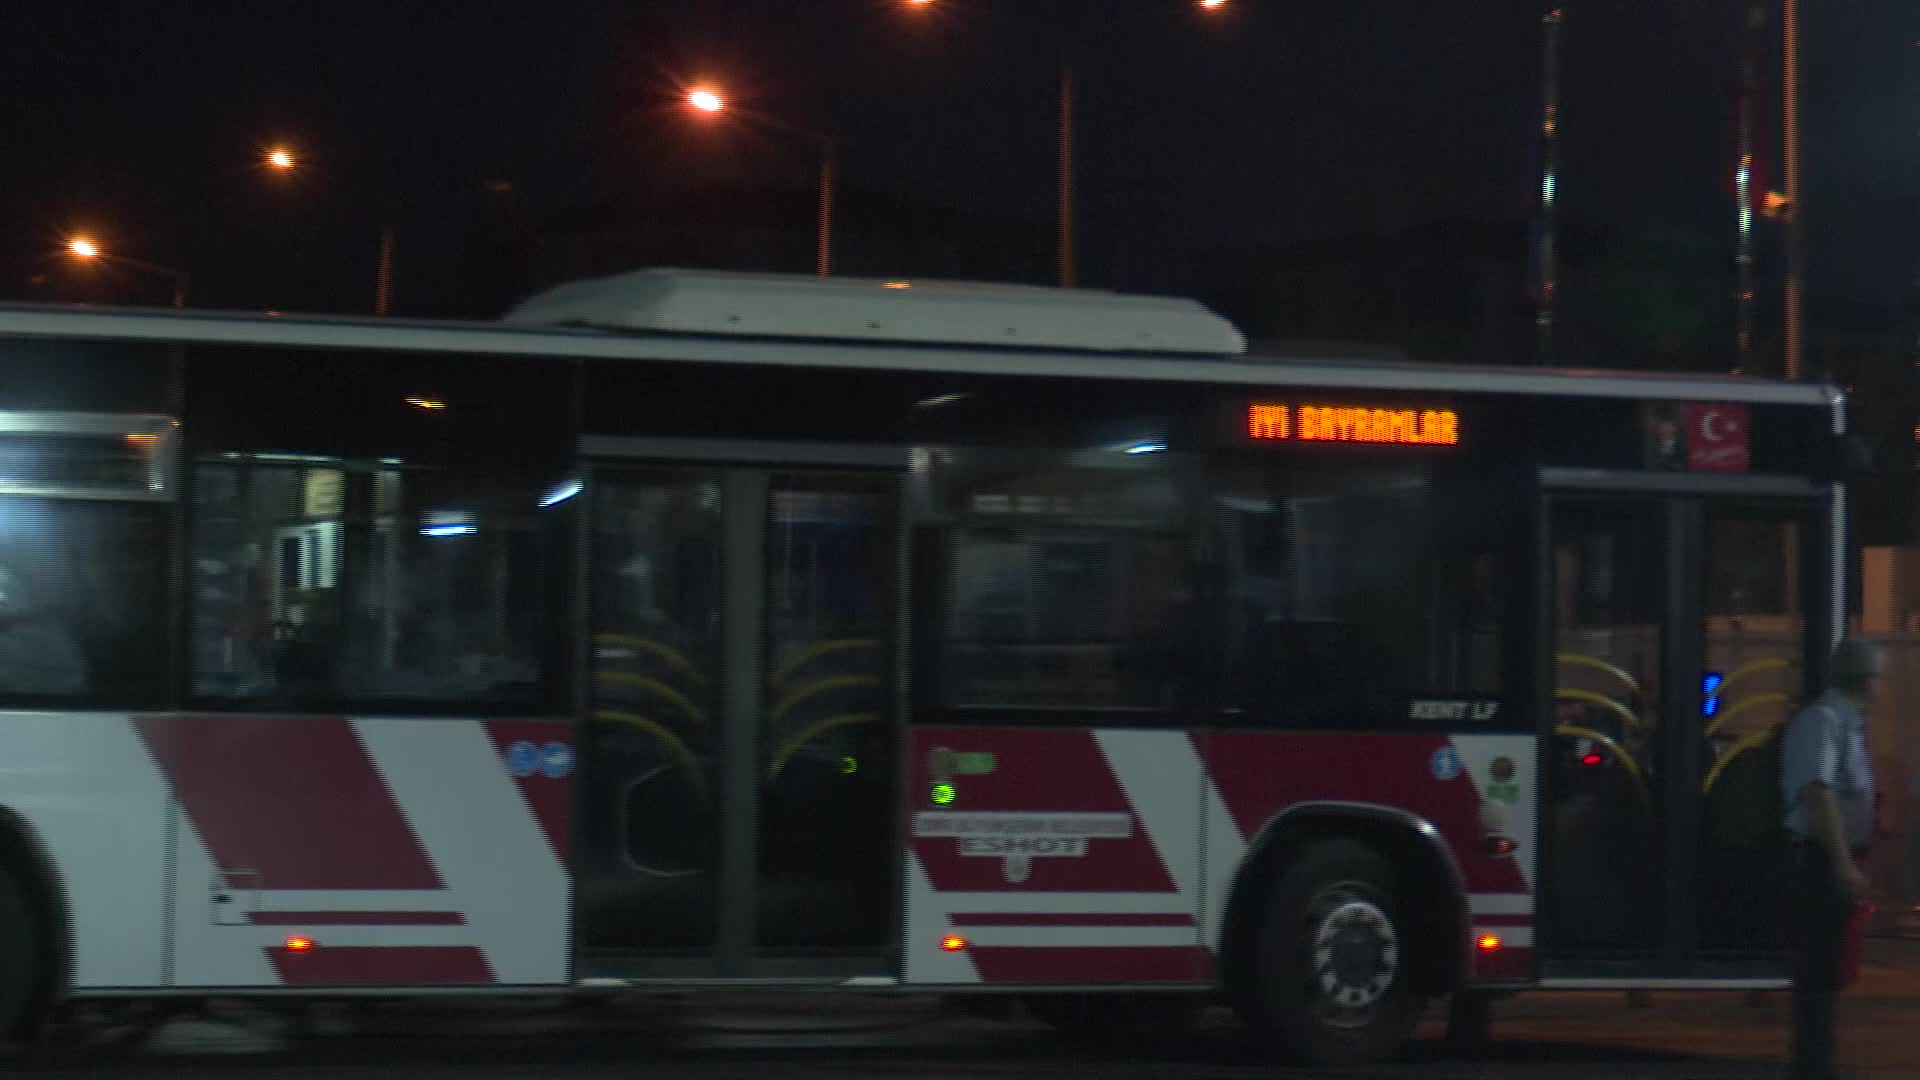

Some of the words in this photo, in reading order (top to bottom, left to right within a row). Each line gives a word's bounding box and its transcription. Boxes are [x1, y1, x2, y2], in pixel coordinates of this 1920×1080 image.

[1298, 406, 1458, 444] BAYRAMLAR
[1408, 701, 1468, 719] KENT
[961, 837, 1080, 855] ESHOT
